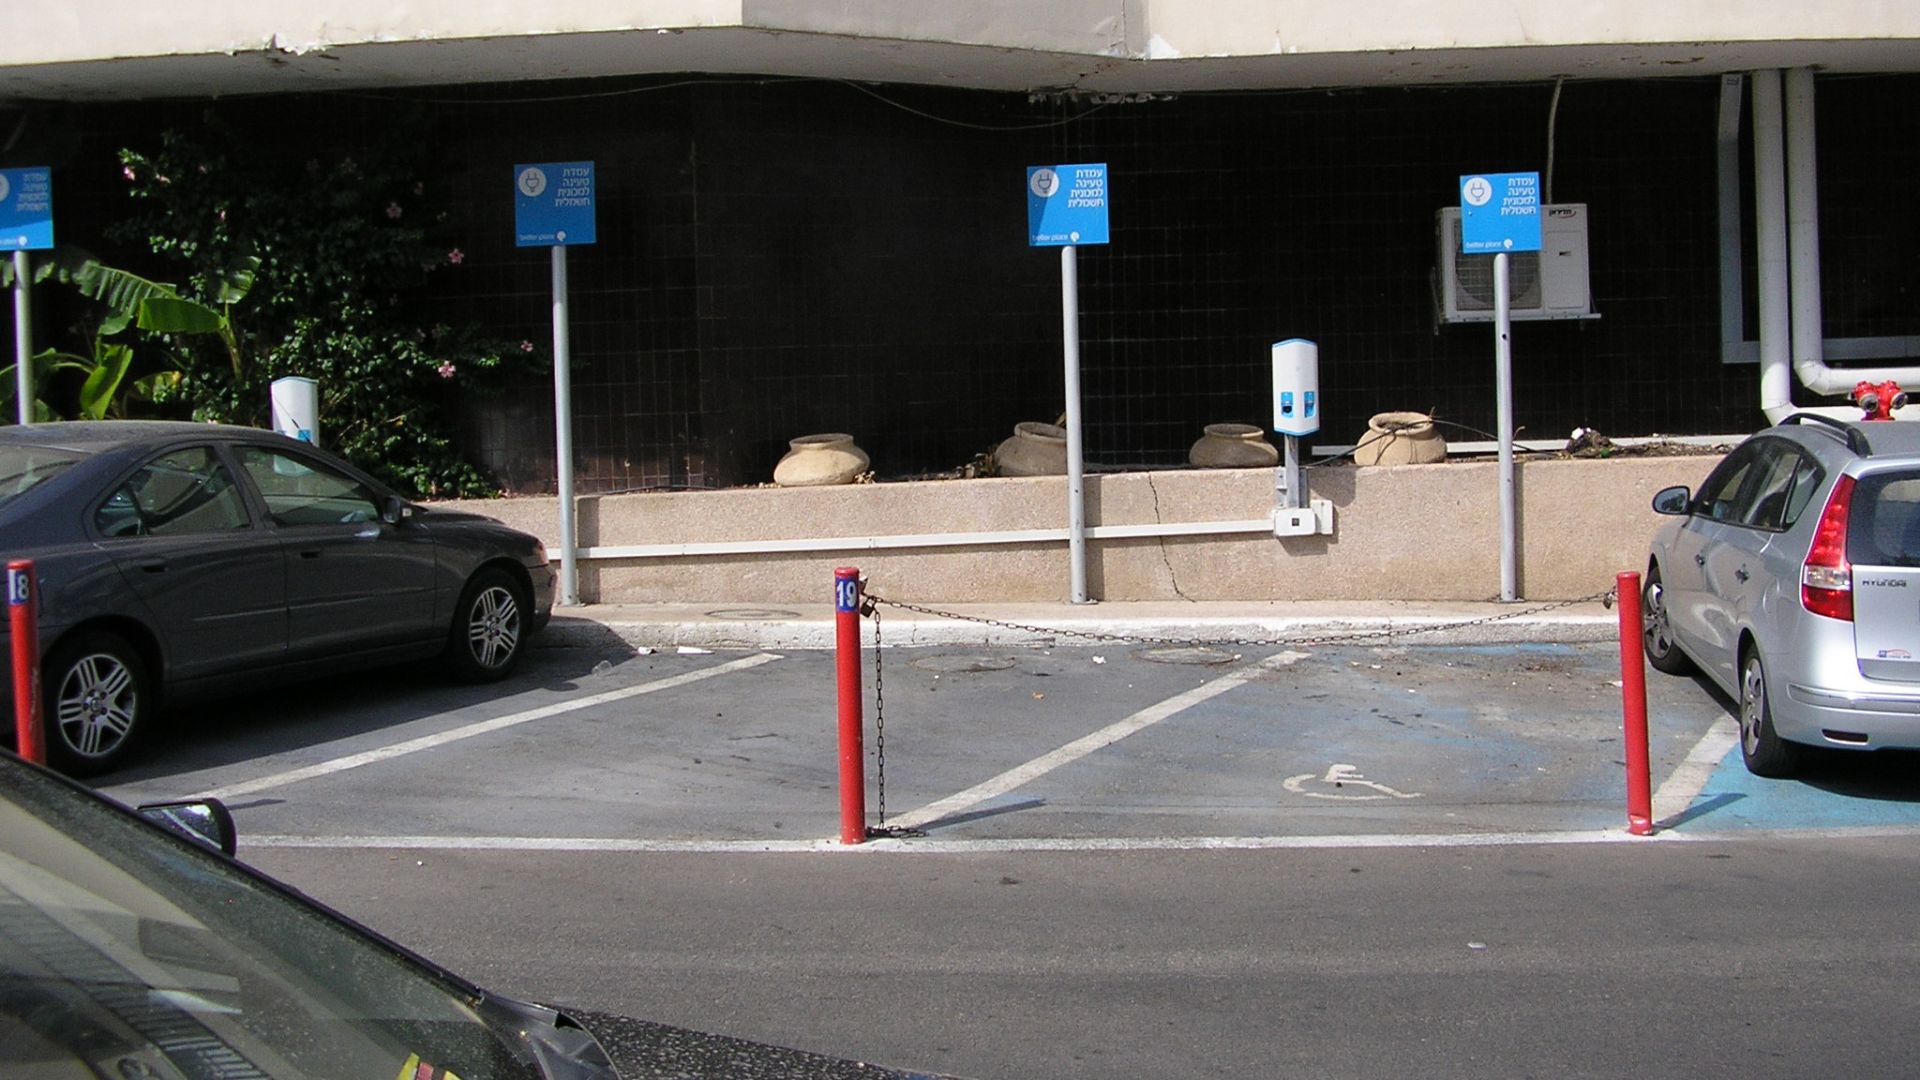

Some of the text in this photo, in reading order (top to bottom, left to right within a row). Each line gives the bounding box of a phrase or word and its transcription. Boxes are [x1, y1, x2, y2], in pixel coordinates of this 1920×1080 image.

[563, 168, 590, 177] עמדת
[1075, 169, 1103, 178] עמדת
[562, 178, 590, 187] טעינה
[1075, 179, 1104, 188] טעינה
[1508, 178, 1535, 187] עמדת
[557, 186, 590, 197] למכונית
[1070, 188, 1104, 198] למכונית
[1508, 187, 1536, 196] טעינה
[555, 197, 591, 207] חשמלית
[1067, 198, 1104, 208] חשמלית
[1503, 196, 1536, 206] למכונית
[1500, 206, 1537, 216] חשמלית
[9, 569, 29, 600] 18
[1862, 579, 1907, 587] HYUNDAI
[837, 581, 857, 607] 19
